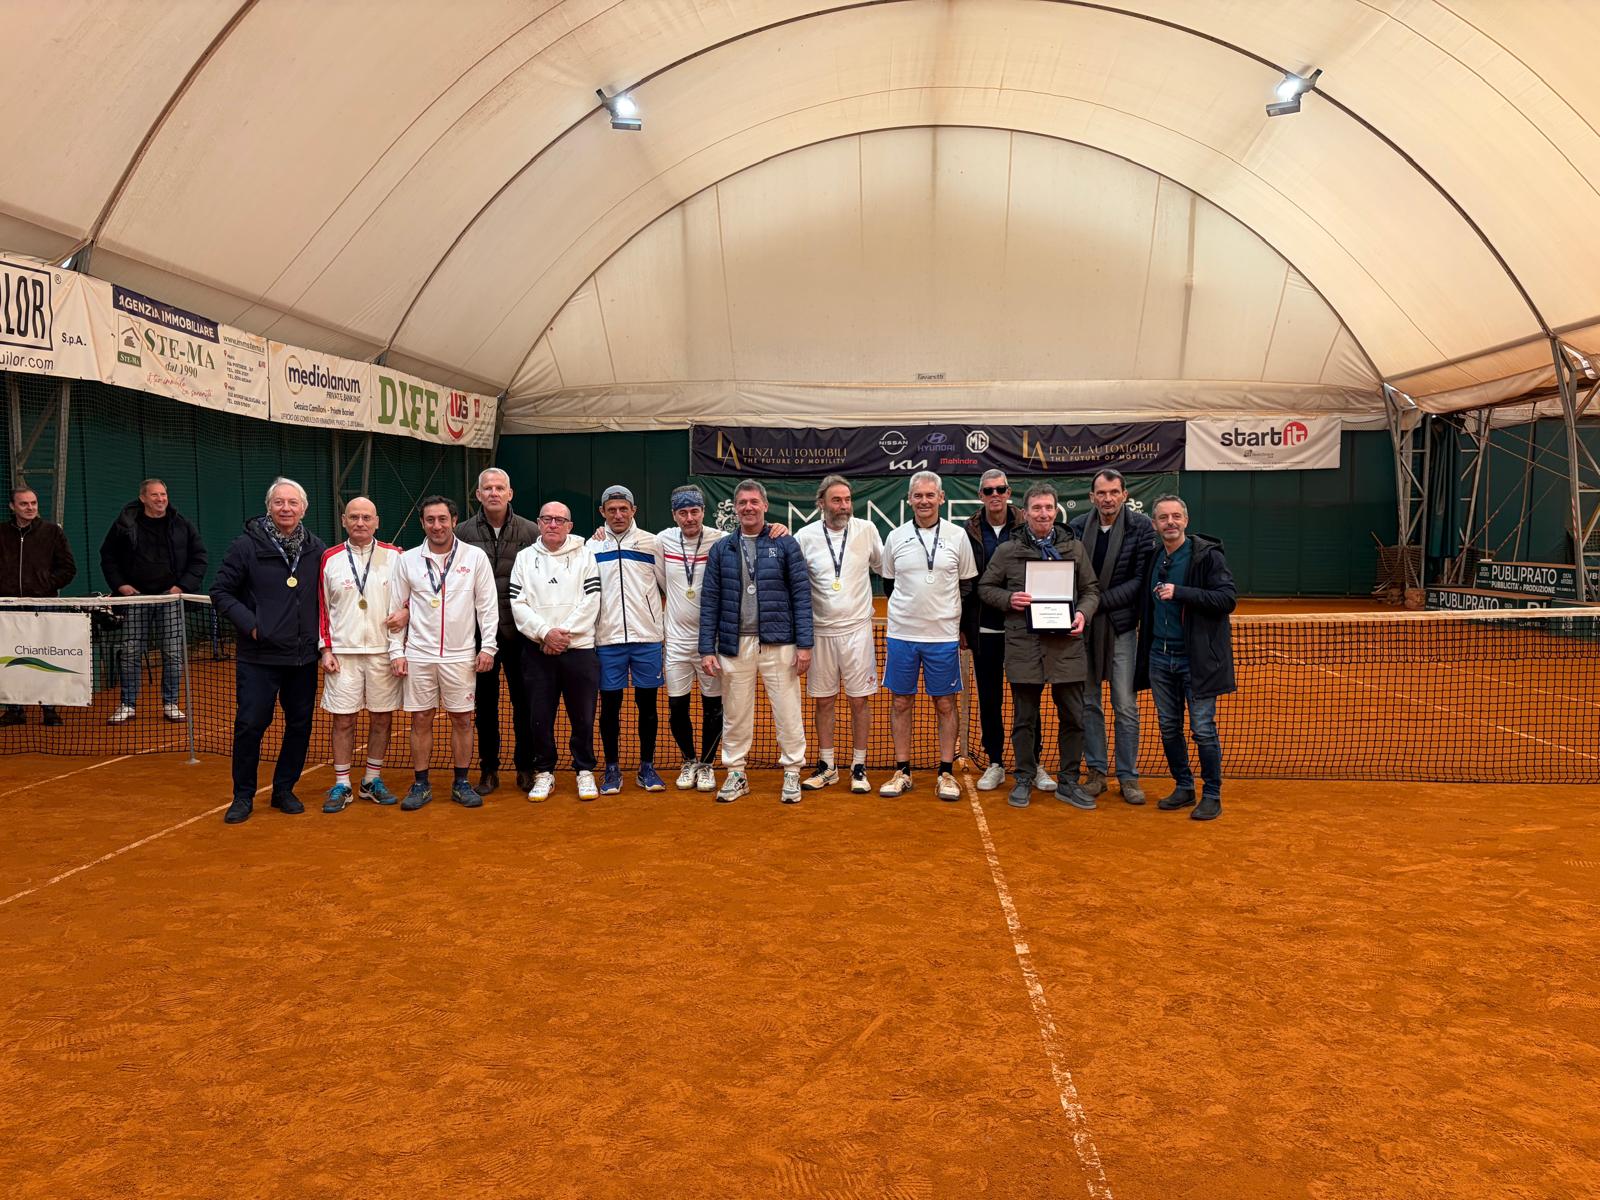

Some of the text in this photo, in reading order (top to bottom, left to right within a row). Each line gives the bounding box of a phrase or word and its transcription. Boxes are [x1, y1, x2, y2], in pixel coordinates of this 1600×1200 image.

[0, 273, 46, 339] LOR
[119, 294, 215, 338] AGENZIA IMMOBILIARE
[61, 332, 87, 346] S.p.A.
[144, 327, 215, 370] STE-MA
[165, 362, 198, 378] dal 1990
[288, 364, 361, 393] mediolanum
[378, 375, 439, 435] DIFE
[917, 444, 956, 452] HYUNDAI
[967, 431, 988, 452] MG
[1049, 442, 1160, 455] LENZI AUTOMOBILI
[742, 447, 847, 457] LENZI AUTOMOBILI
[889, 459, 928, 470] KIA
[1491, 565, 1557, 585] PUBLIPRATO
[1523, 583, 1556, 594] PRODUZIONE
[1440, 591, 1499, 610] PUBLIPRATO
[14, 645, 83, 656] ChiantiBanca
